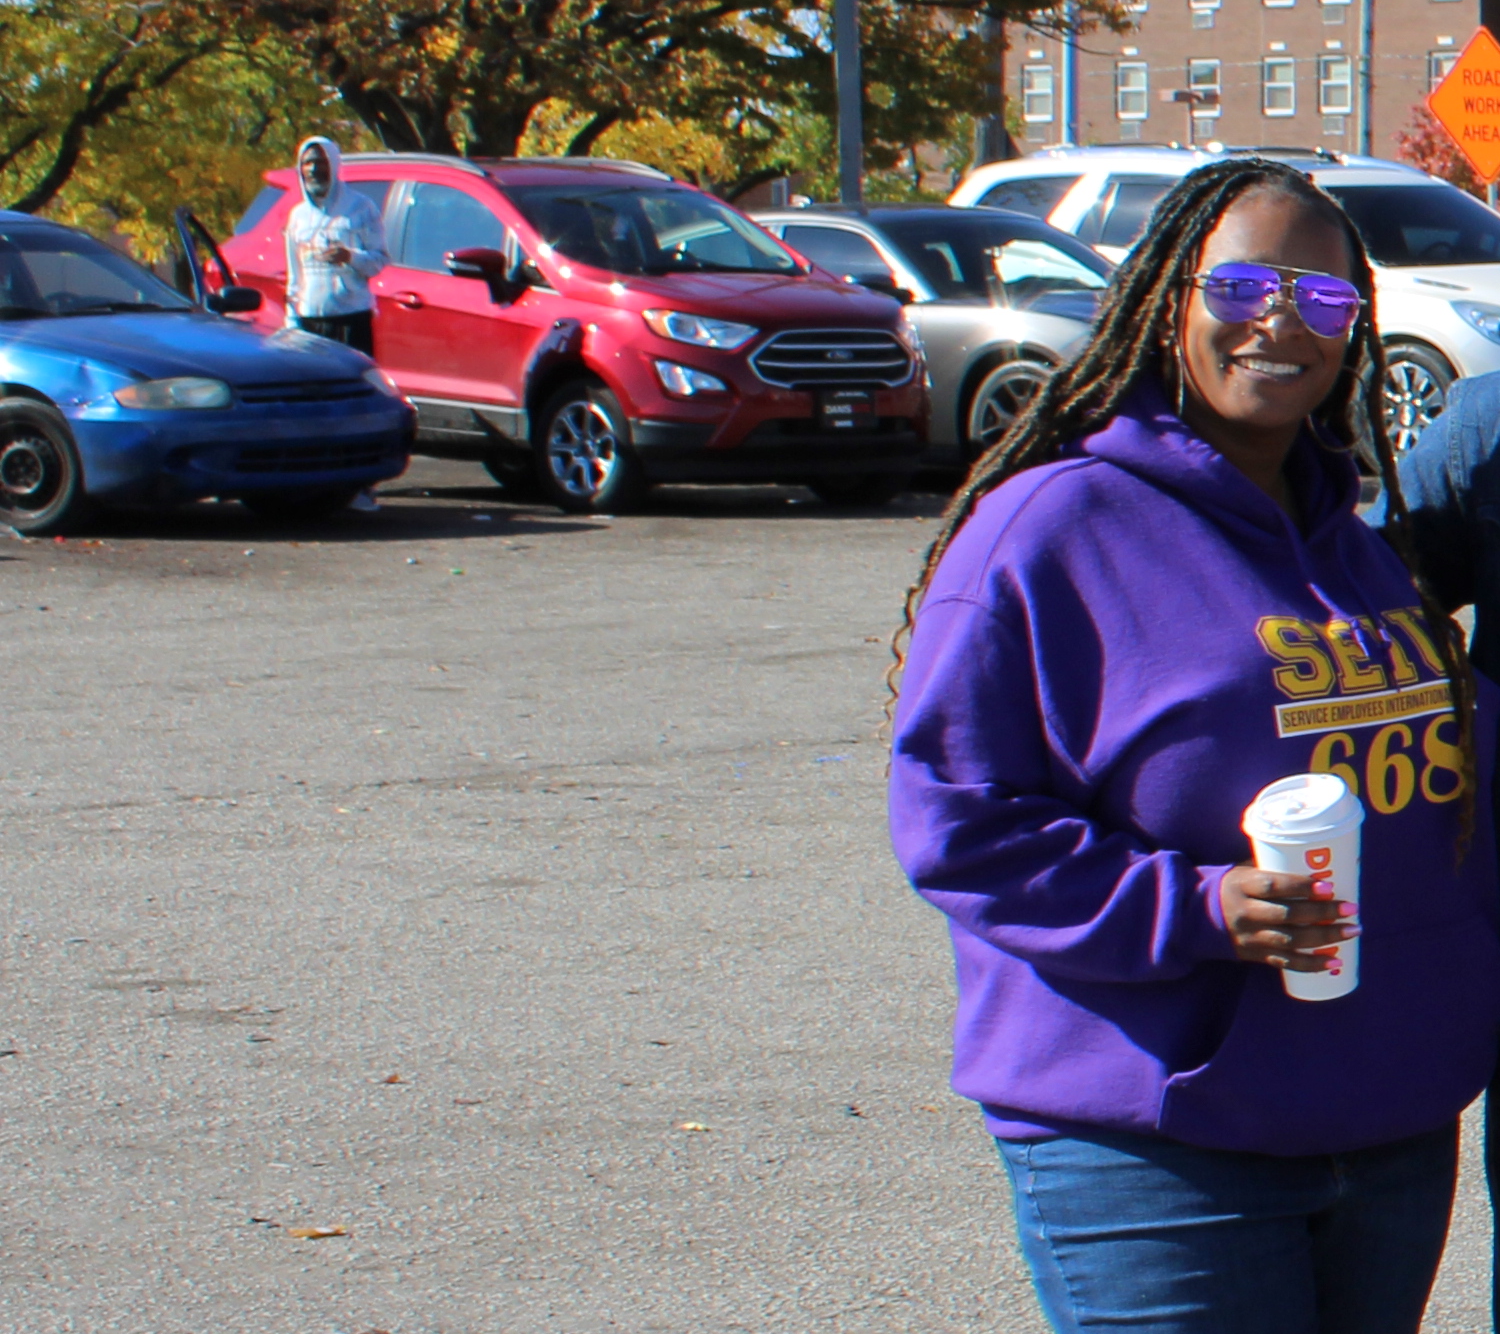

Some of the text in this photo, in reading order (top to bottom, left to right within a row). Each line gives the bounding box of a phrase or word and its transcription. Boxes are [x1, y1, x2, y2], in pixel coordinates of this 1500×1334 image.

[1284, 705, 1329, 729] SERVICE
[1332, 700, 1385, 723] EMPLOYEES
[1309, 714, 1466, 815] 668
